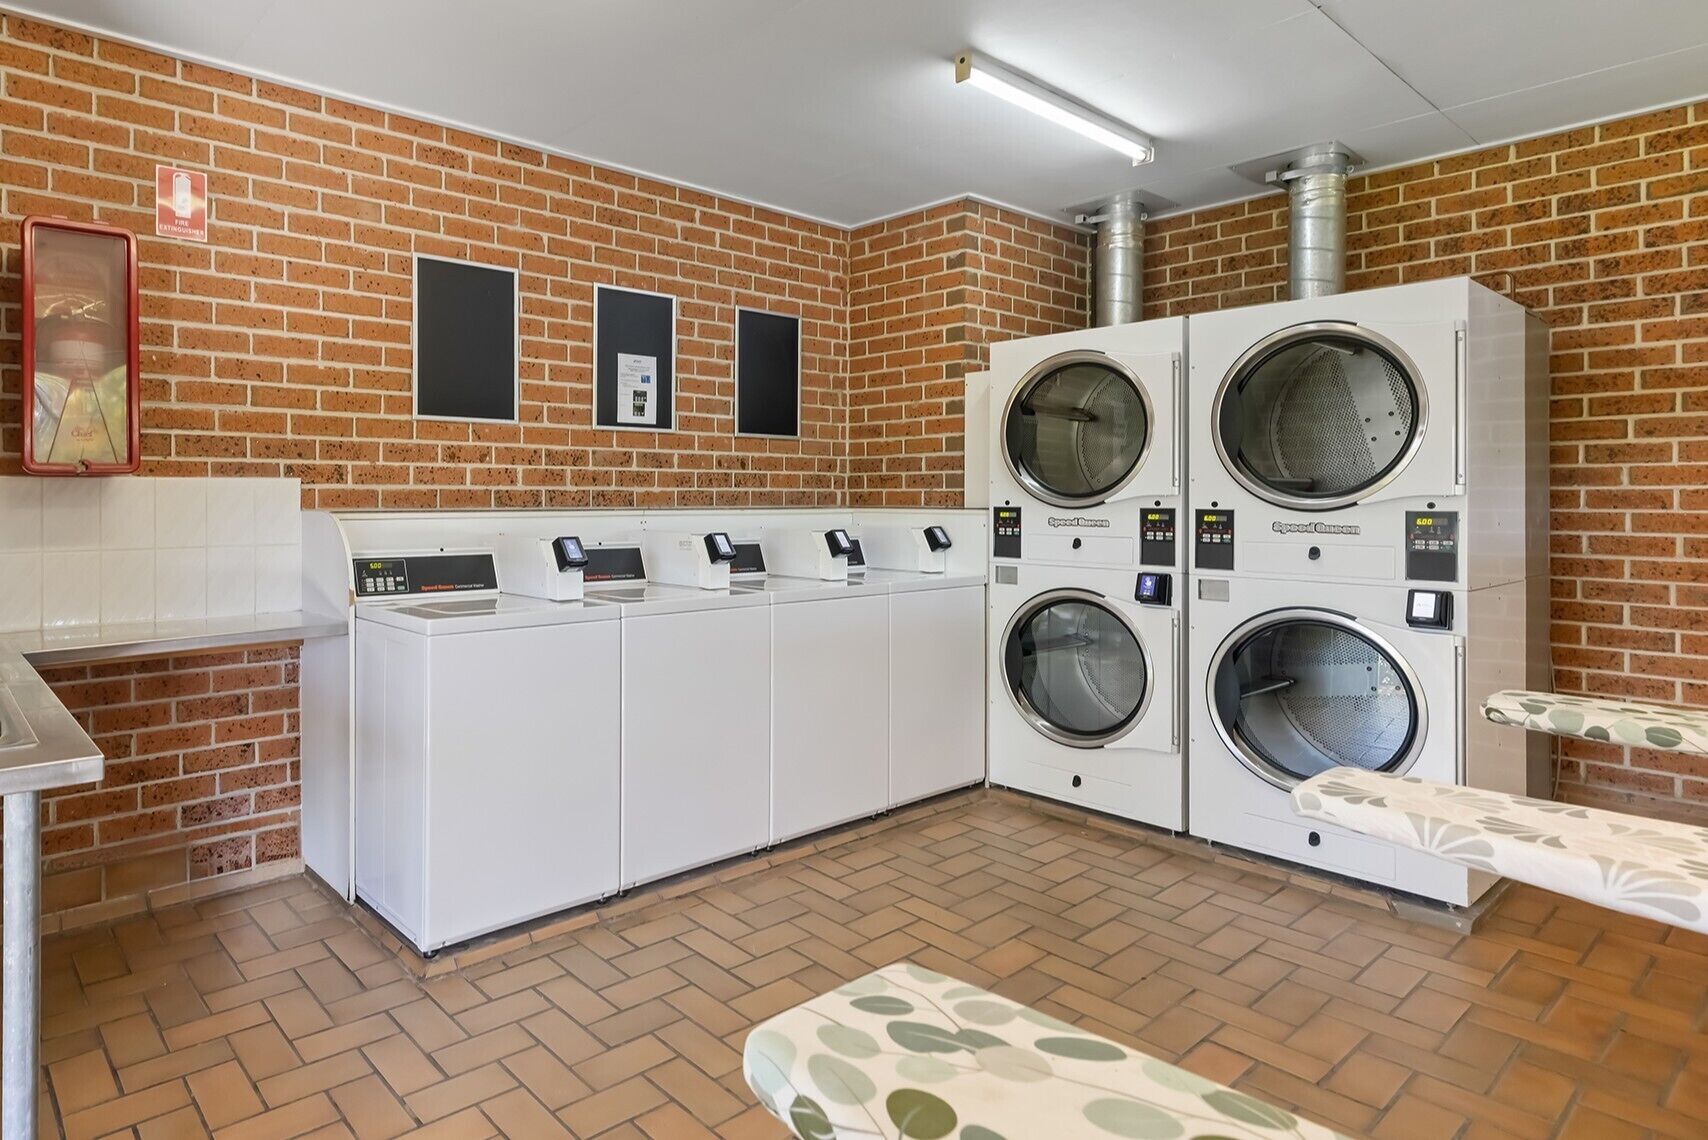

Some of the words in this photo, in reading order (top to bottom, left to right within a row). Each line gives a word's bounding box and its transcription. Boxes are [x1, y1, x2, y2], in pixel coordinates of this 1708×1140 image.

[174, 219, 190, 227] FIRE
[159, 224, 205, 236] EXTINGUISHER
[1048, 517, 1079, 528] Speed
[1078, 517, 1110, 528] Queen
[1272, 521, 1316, 534] Speed
[1314, 522, 1360, 535] Queen
